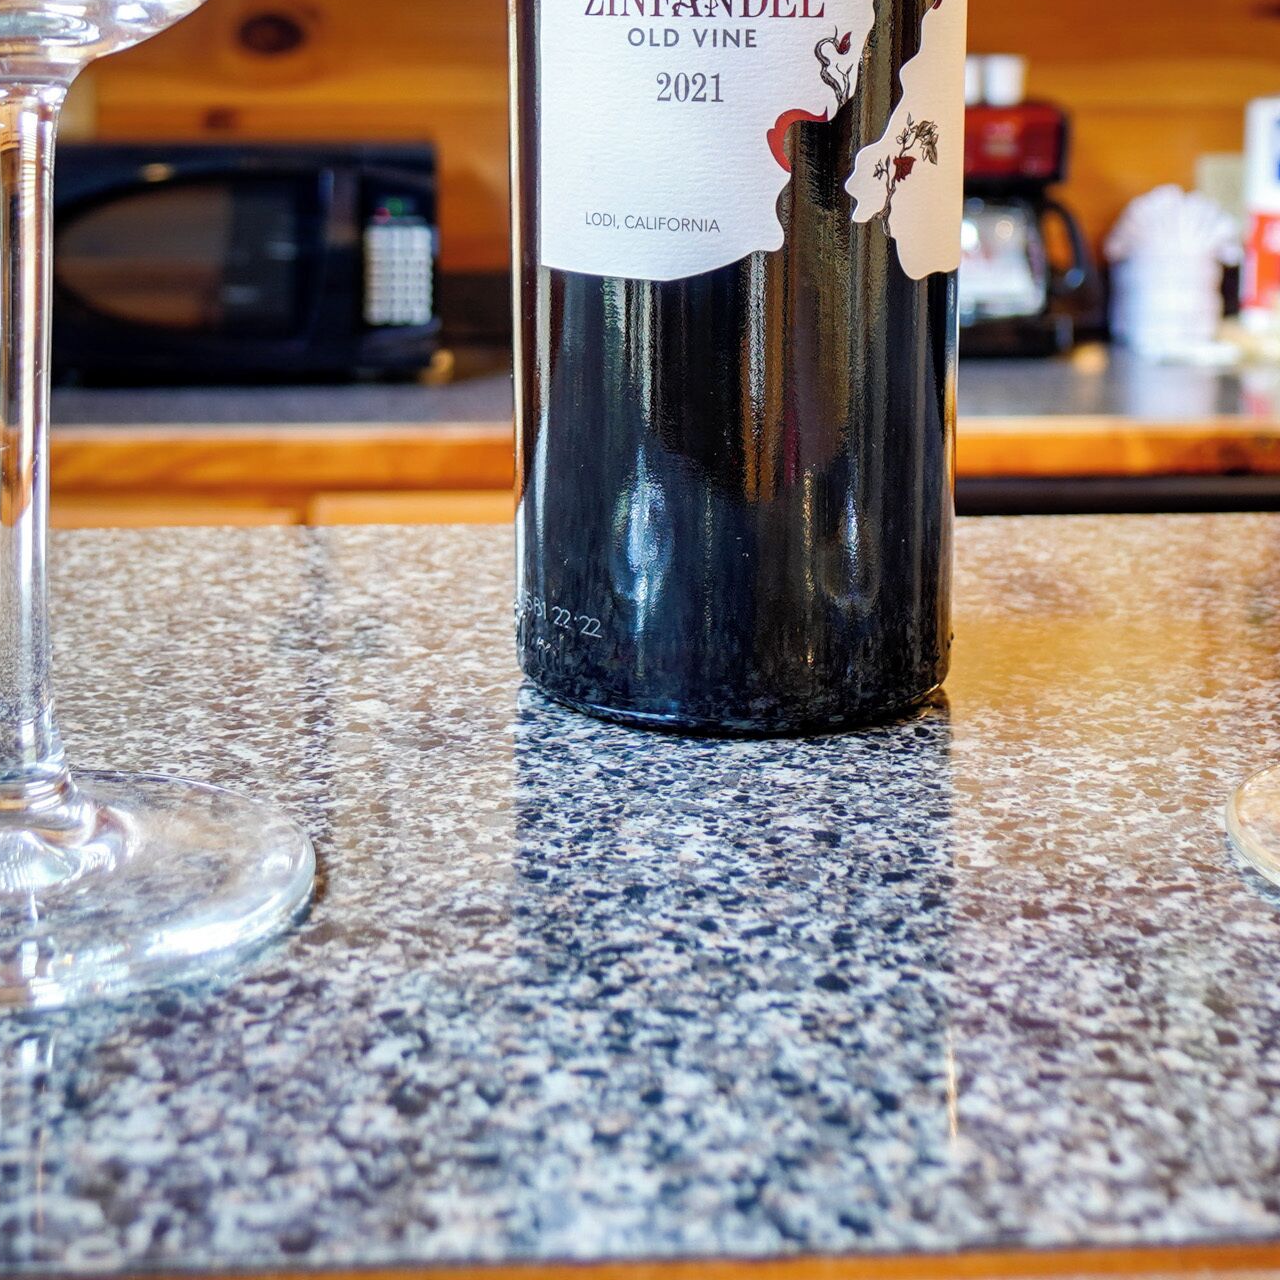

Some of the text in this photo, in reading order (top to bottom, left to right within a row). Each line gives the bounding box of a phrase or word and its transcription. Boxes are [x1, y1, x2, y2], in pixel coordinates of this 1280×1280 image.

[627, 27, 757, 48] OLD VINE
[656, 72, 724, 103] 2021
[585, 211, 721, 233] LODI, CALIFORNIA
